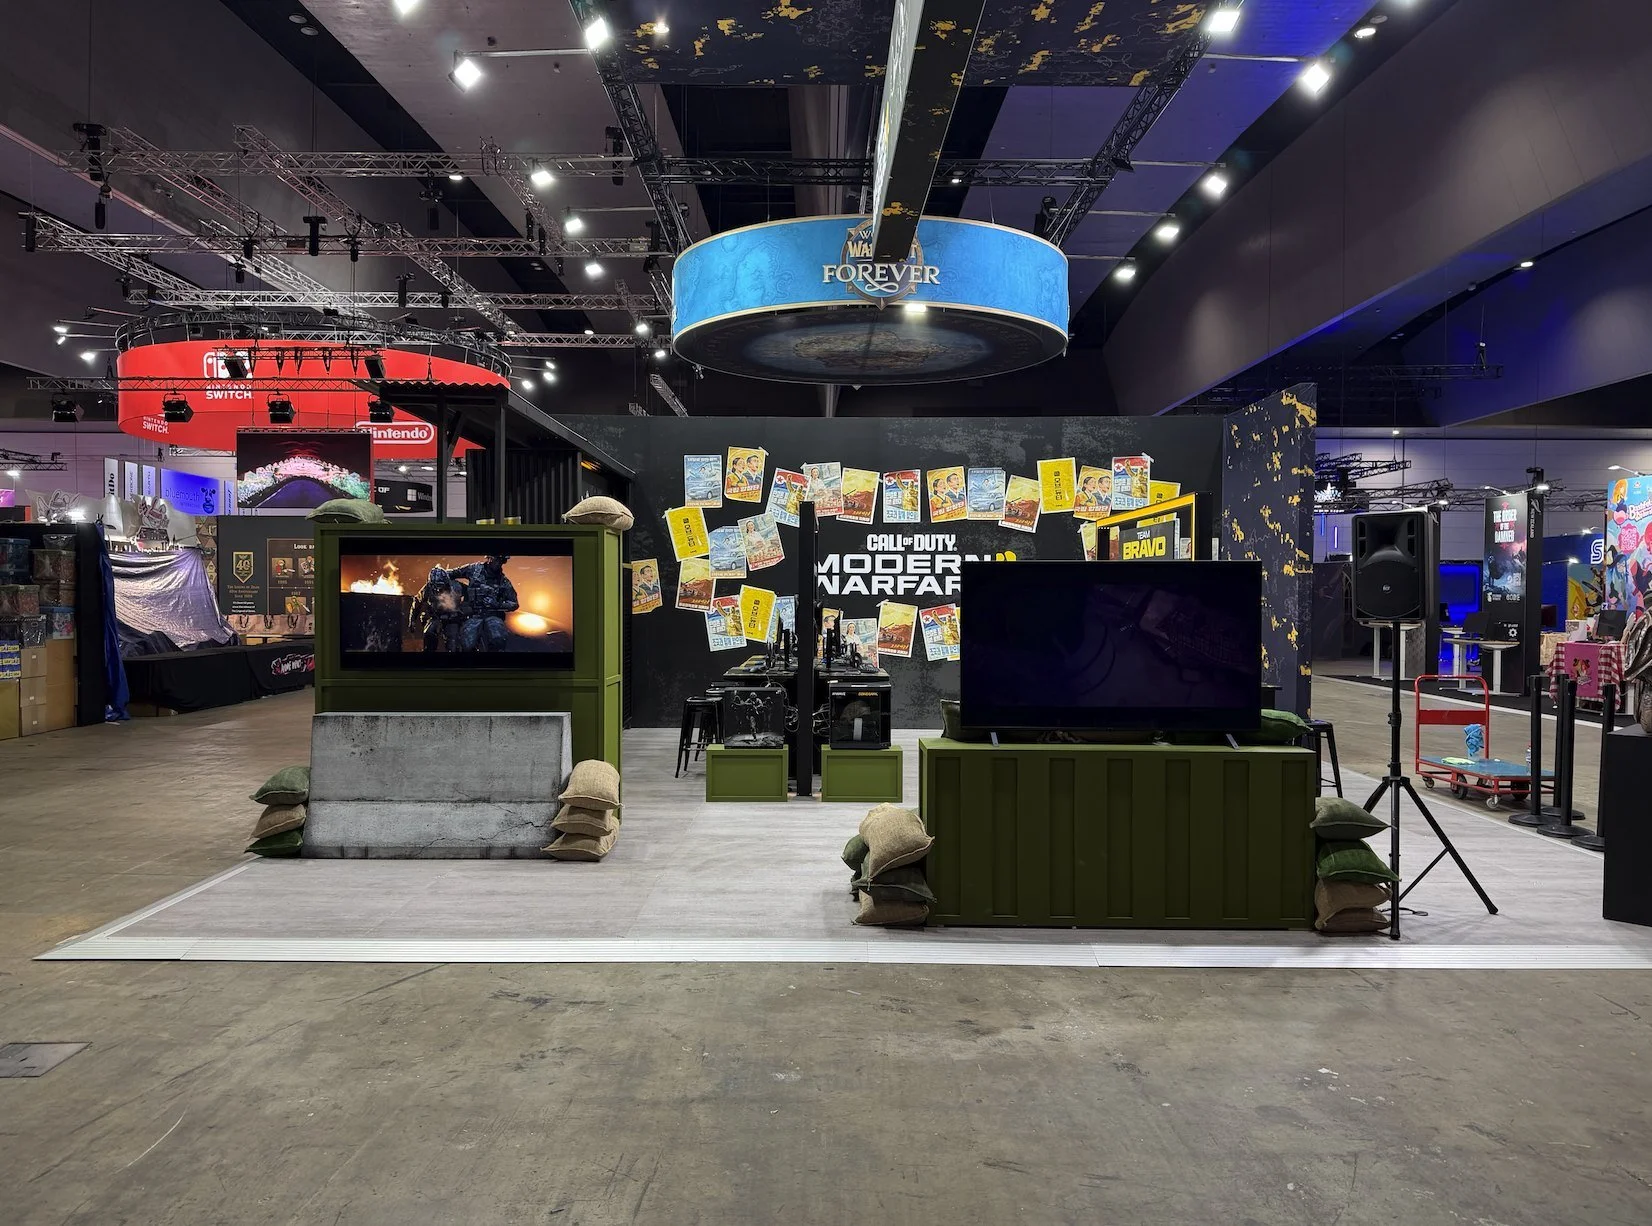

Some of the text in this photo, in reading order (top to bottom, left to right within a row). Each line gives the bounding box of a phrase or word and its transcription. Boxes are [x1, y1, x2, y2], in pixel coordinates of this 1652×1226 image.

[822, 263, 940, 293] FOREVER
[206, 390, 252, 400] SWITCH
[142, 420, 169, 434] SWITCH
[143, 416, 169, 426] NINTENDO
[1136, 530, 1151, 540] TEAM
[866, 534, 956, 552] CALL OF DUTY
[1123, 536, 1166, 560] BRAVO
